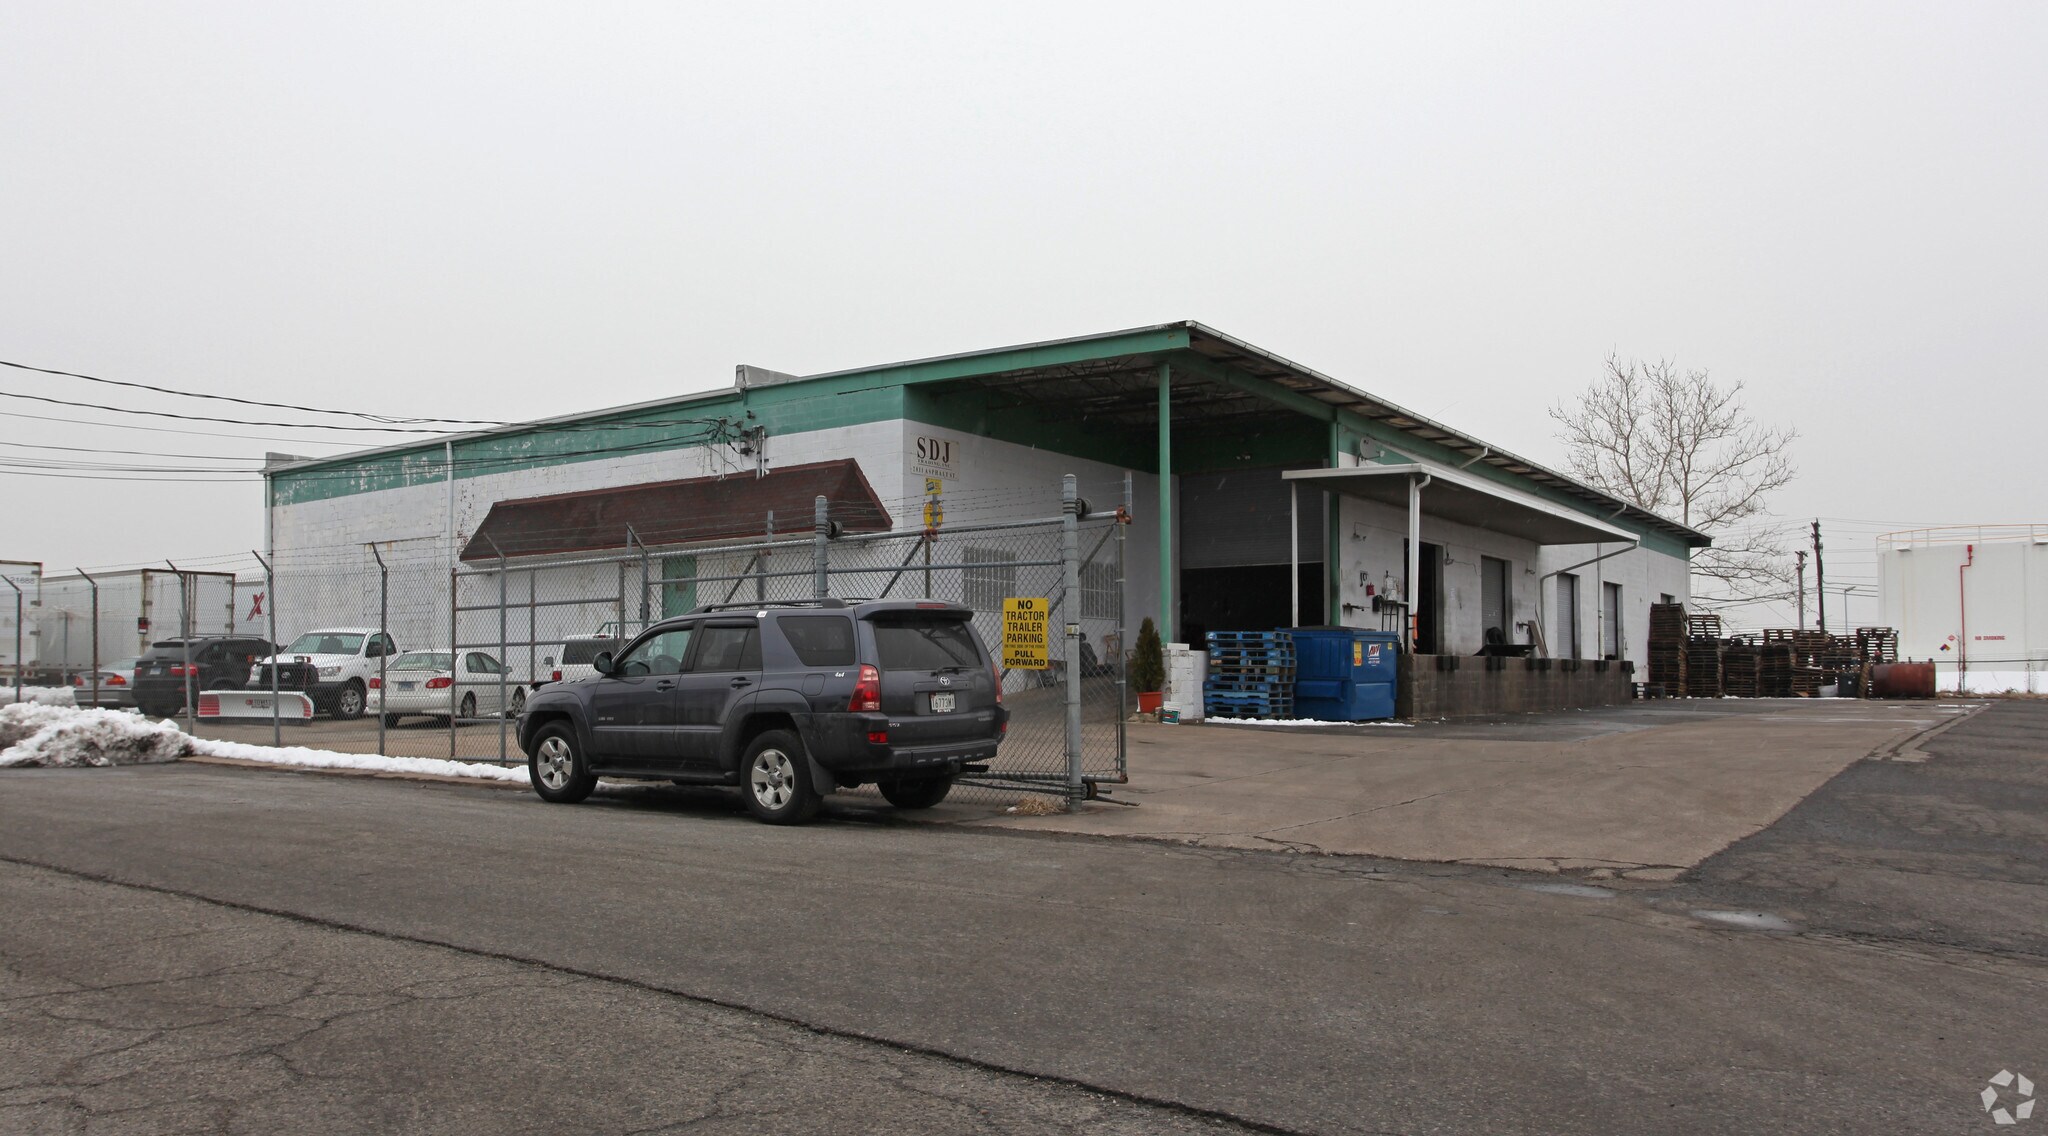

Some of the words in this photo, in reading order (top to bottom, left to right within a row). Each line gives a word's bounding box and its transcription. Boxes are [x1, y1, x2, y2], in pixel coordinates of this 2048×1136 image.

[917, 436, 950, 463] SDJ
[1017, 600, 1033, 610] NO
[1005, 611, 1045, 621] TRACTOR
[1007, 622, 1043, 632] TRAILER
[1006, 633, 1043, 643] PARKING
[1014, 650, 1035, 658] PULL
[1004, 658, 1046, 667] FORWARD
